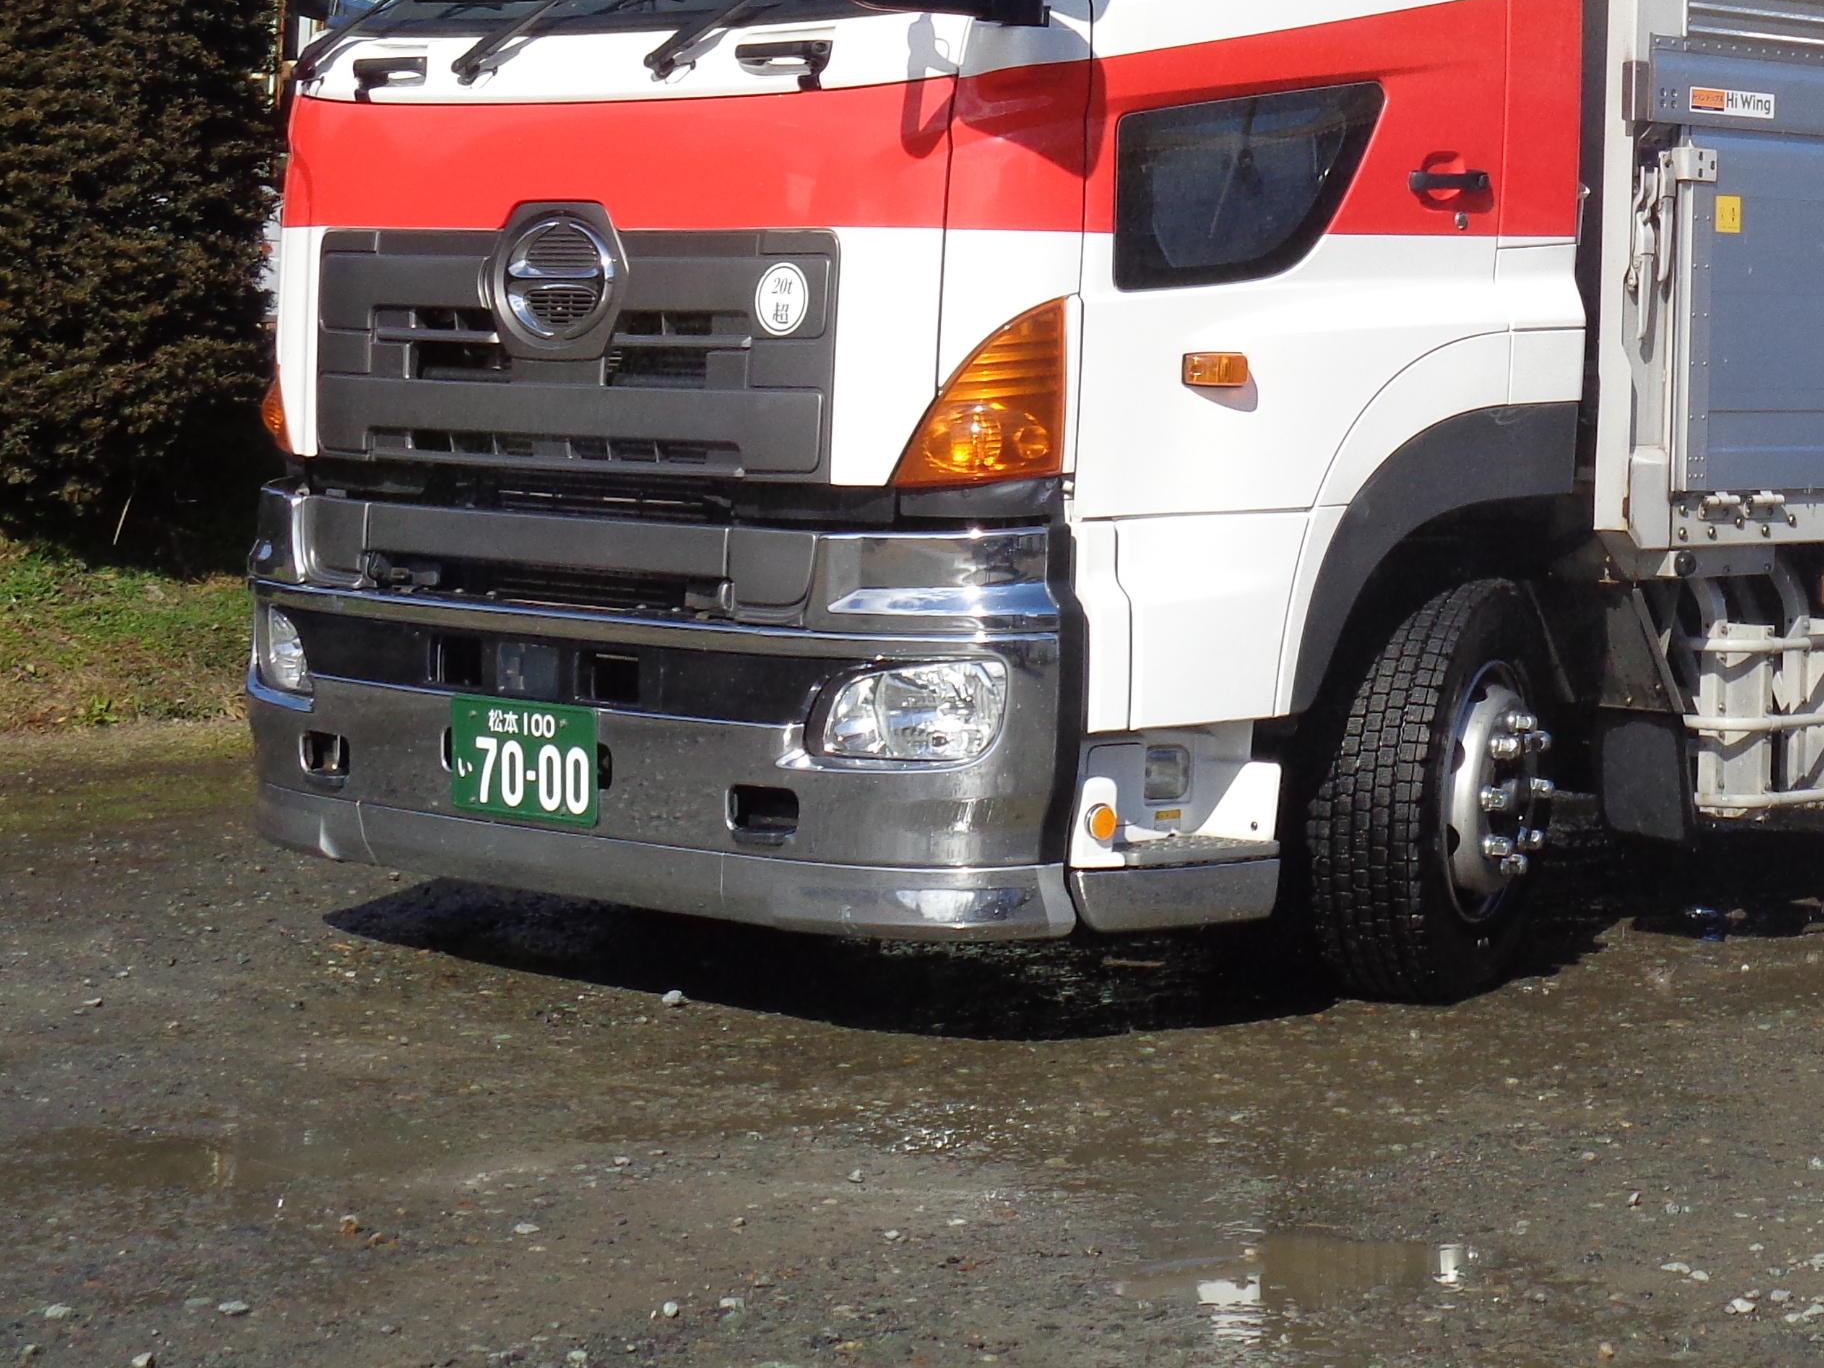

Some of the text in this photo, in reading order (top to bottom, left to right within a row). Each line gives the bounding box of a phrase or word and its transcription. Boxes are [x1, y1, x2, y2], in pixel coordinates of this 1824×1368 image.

[1726, 91, 1771, 115] Hi Wing
[771, 277, 793, 295] 20t
[772, 301, 789, 324] 超
[457, 736, 589, 815] い 70-00
